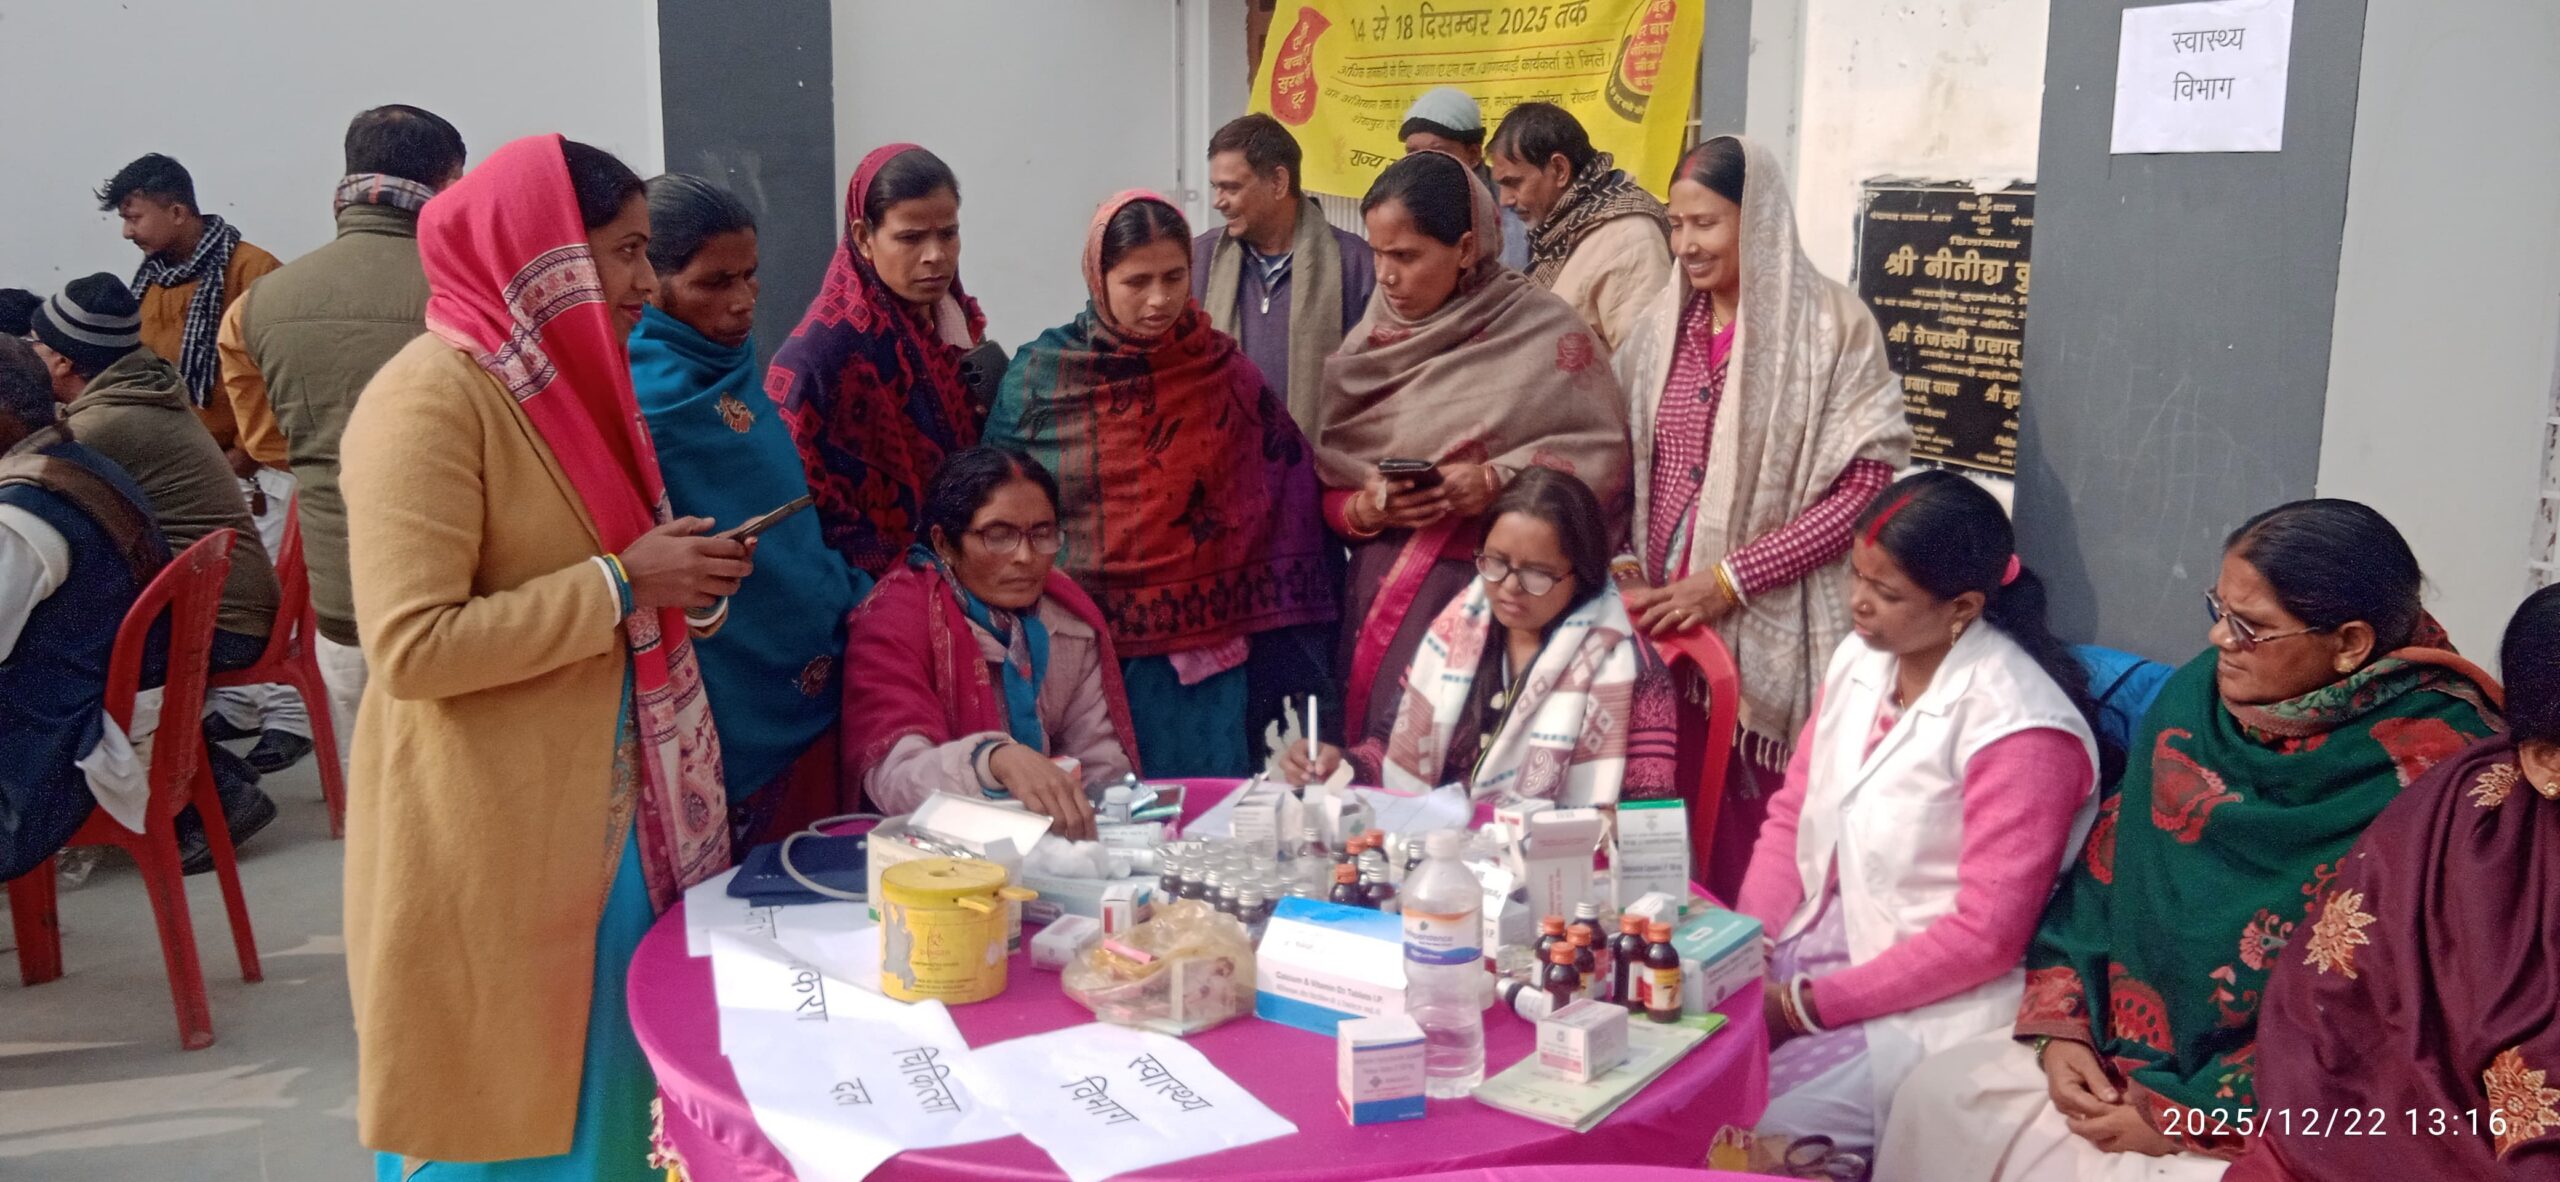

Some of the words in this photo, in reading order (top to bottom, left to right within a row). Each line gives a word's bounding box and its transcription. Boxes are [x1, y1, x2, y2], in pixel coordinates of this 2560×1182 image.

[1350, 17, 1366, 42] 14
[1372, 6, 1390, 41] से
[1396, 14, 1414, 41] 18
[1419, 1, 1493, 39] दिसम्बर
[1497, 6, 1553, 36] 2025
[1554, 0, 1590, 30] तक
[2171, 27, 2246, 54] स्वास्थ्य
[2173, 71, 2236, 102] विभाग
[1884, 244, 1919, 277] श्री
[1923, 247, 2010, 286] नीतीश
[1888, 322, 1910, 344] श्री
[1913, 324, 1971, 350] तेजस्वी
[1973, 335, 2021, 358] प्रसाद
[829, 1075, 874, 1107] दल
[893, 1045, 962, 1114] चिकित्सा
[1061, 1074, 1142, 1126] विभाग
[1127, 1051, 1214, 1114] स्वास्थ्य
